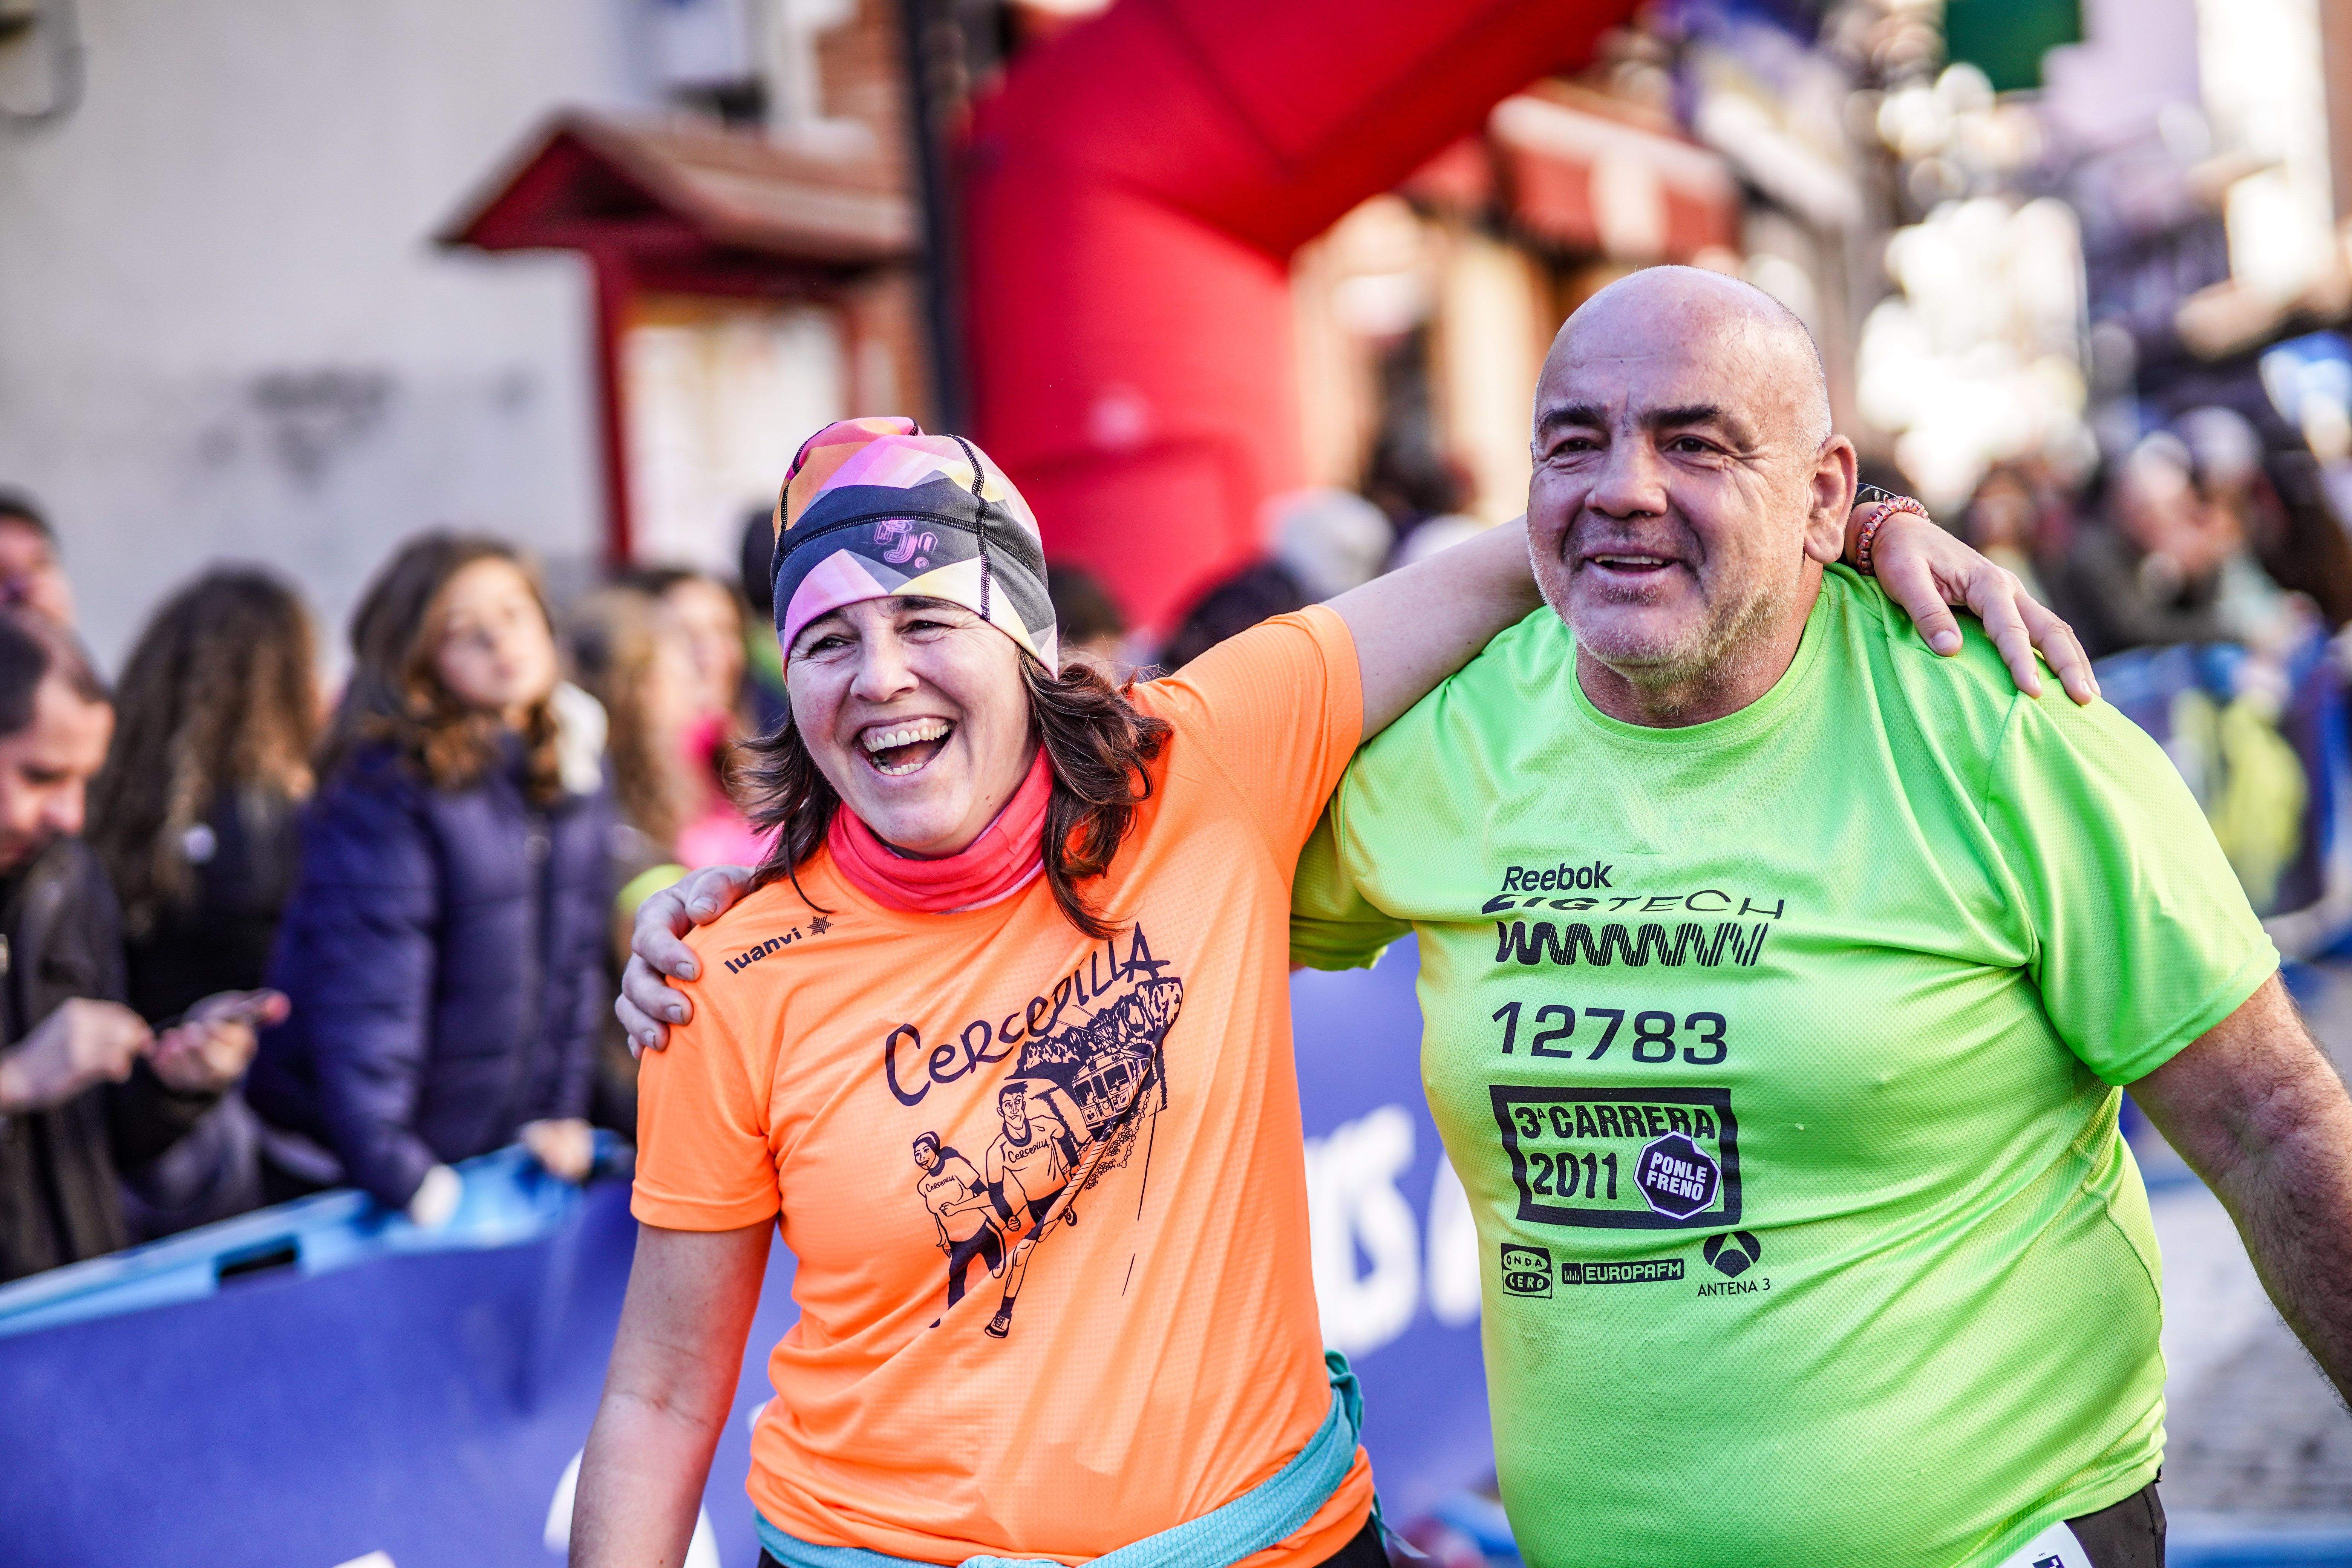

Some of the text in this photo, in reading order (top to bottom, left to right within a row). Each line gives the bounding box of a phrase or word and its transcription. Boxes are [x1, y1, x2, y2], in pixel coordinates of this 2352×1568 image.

[1501, 861, 1613, 891] Reebok
[724, 927, 802, 974] luanvi
[1492, 1001, 1727, 1065] 12783
[1548, 1105, 1716, 1139] CARRERA
[1530, 1152, 1617, 1199] 2011
[1650, 1152, 1707, 1184] PONLE
[1646, 1170, 1703, 1201] FRENO
[1506, 1255, 1542, 1267] ONDA
[1509, 1275, 1544, 1289] CERO
[1697, 1278, 1770, 1297] ANTENA 3
